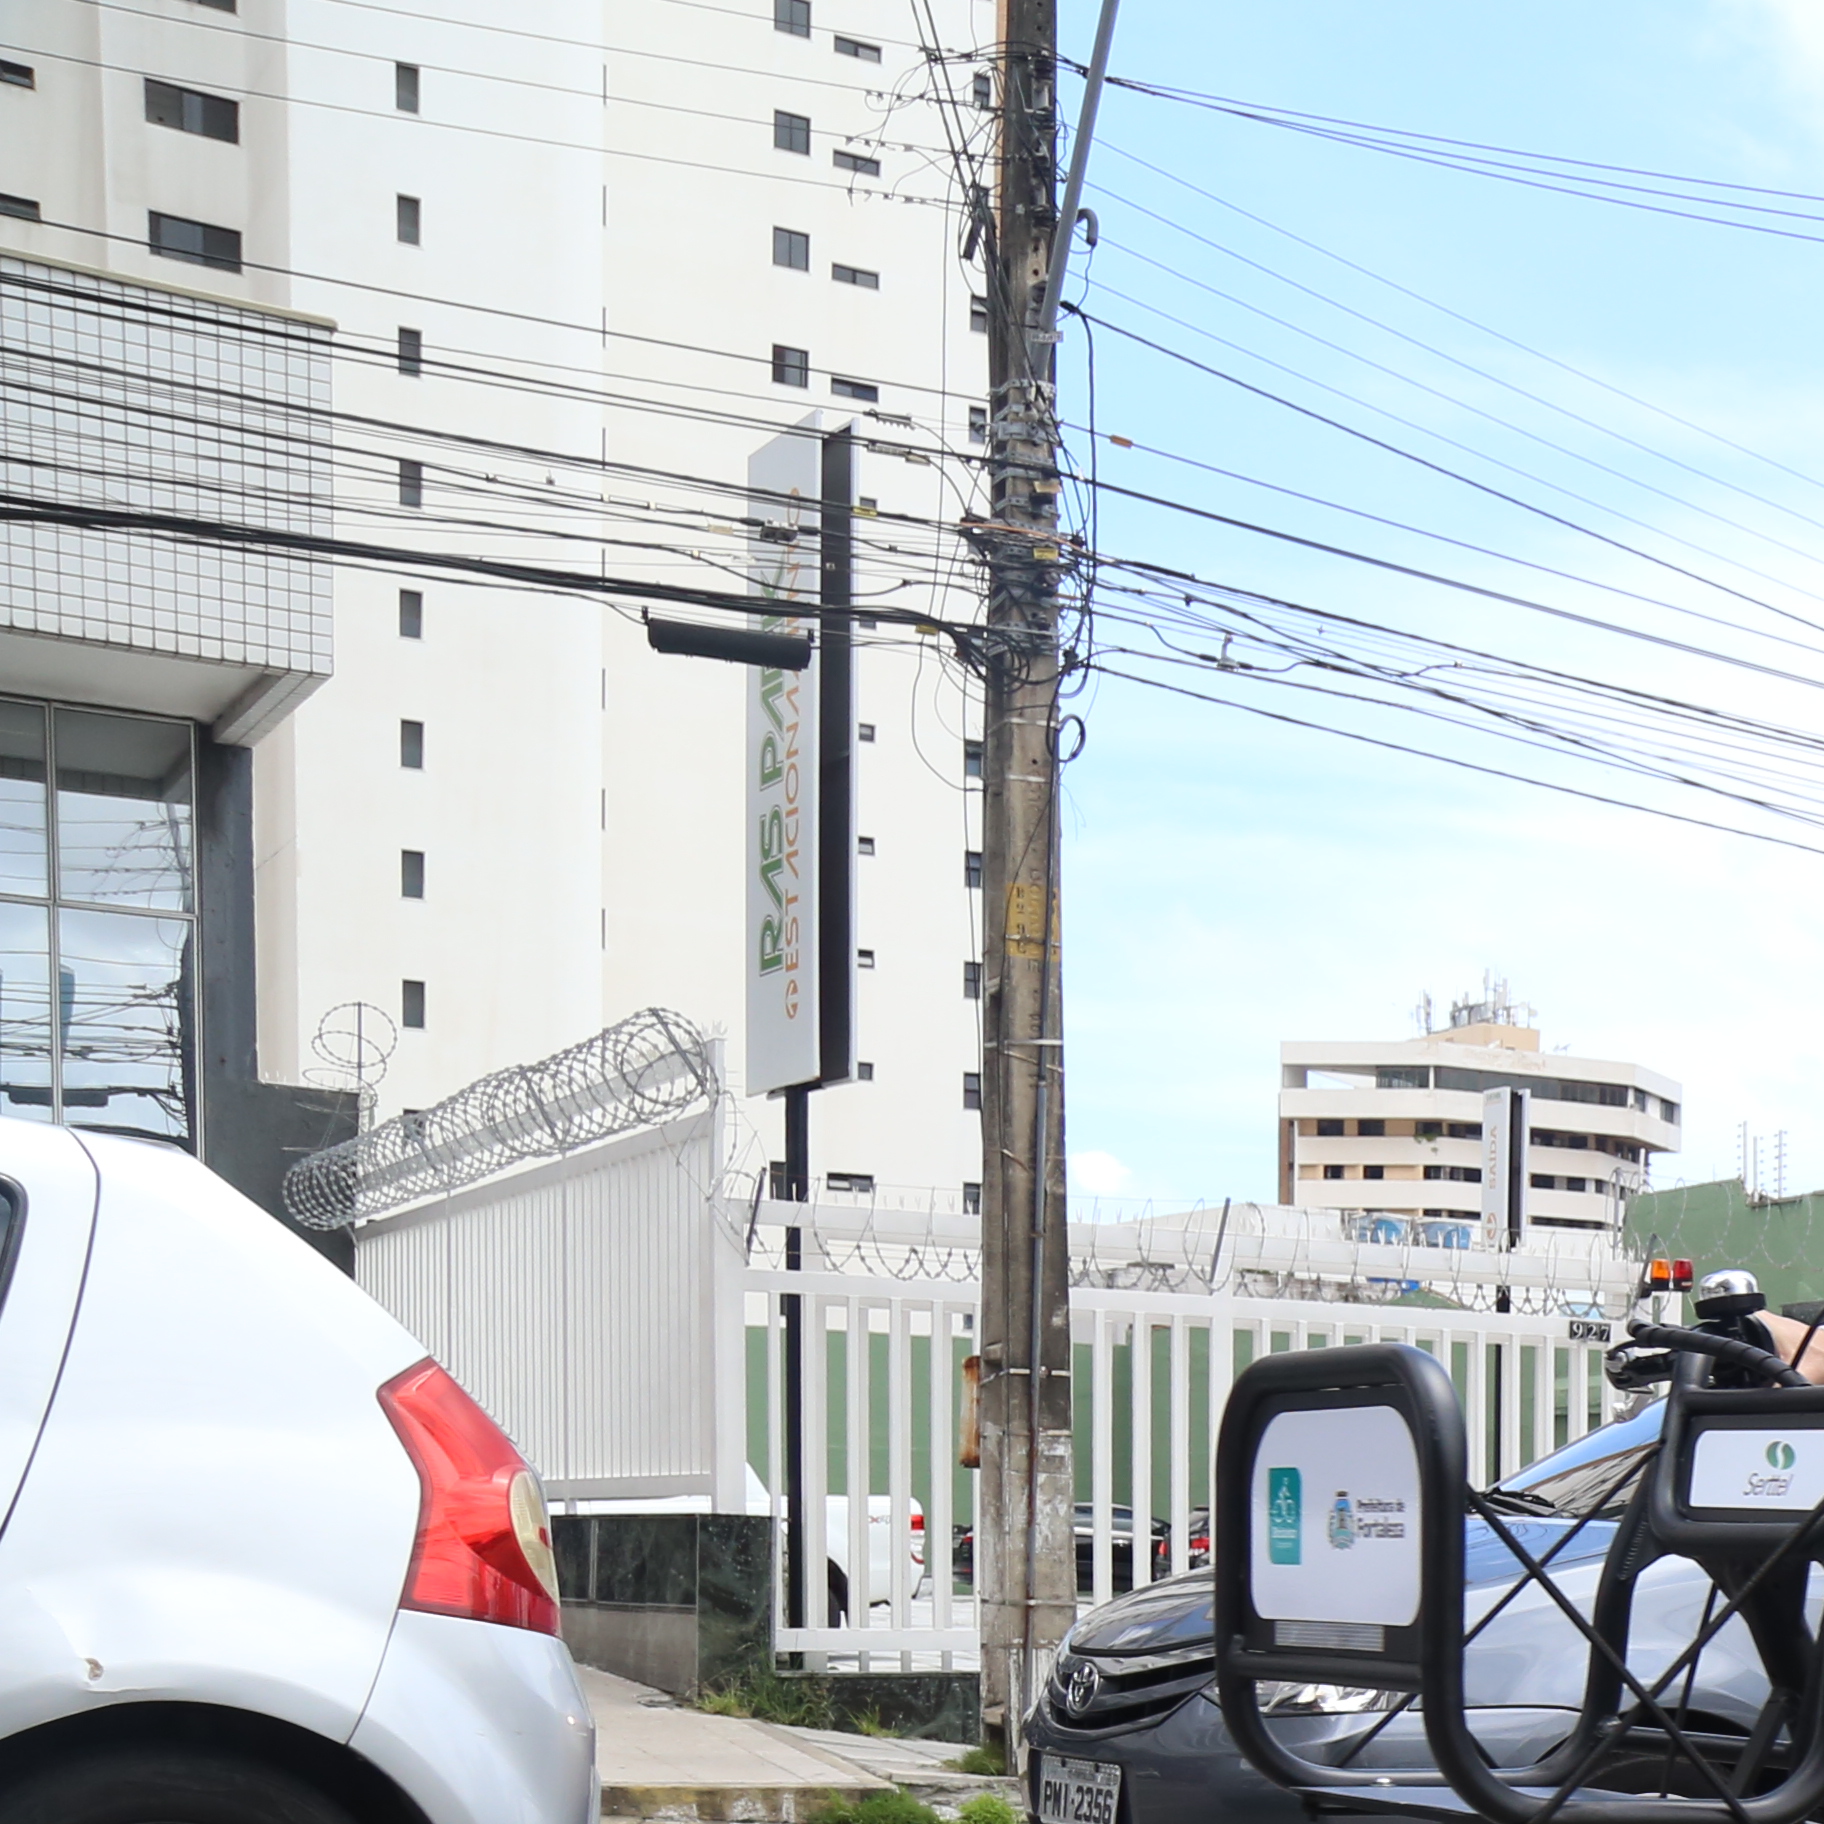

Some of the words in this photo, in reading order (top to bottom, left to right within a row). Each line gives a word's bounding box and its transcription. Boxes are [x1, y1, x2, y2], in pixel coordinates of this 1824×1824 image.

[759, 804, 785, 978] RAS
[1572, 1323, 1611, 1341] 927
[1742, 1471, 1795, 1497] Serttel
